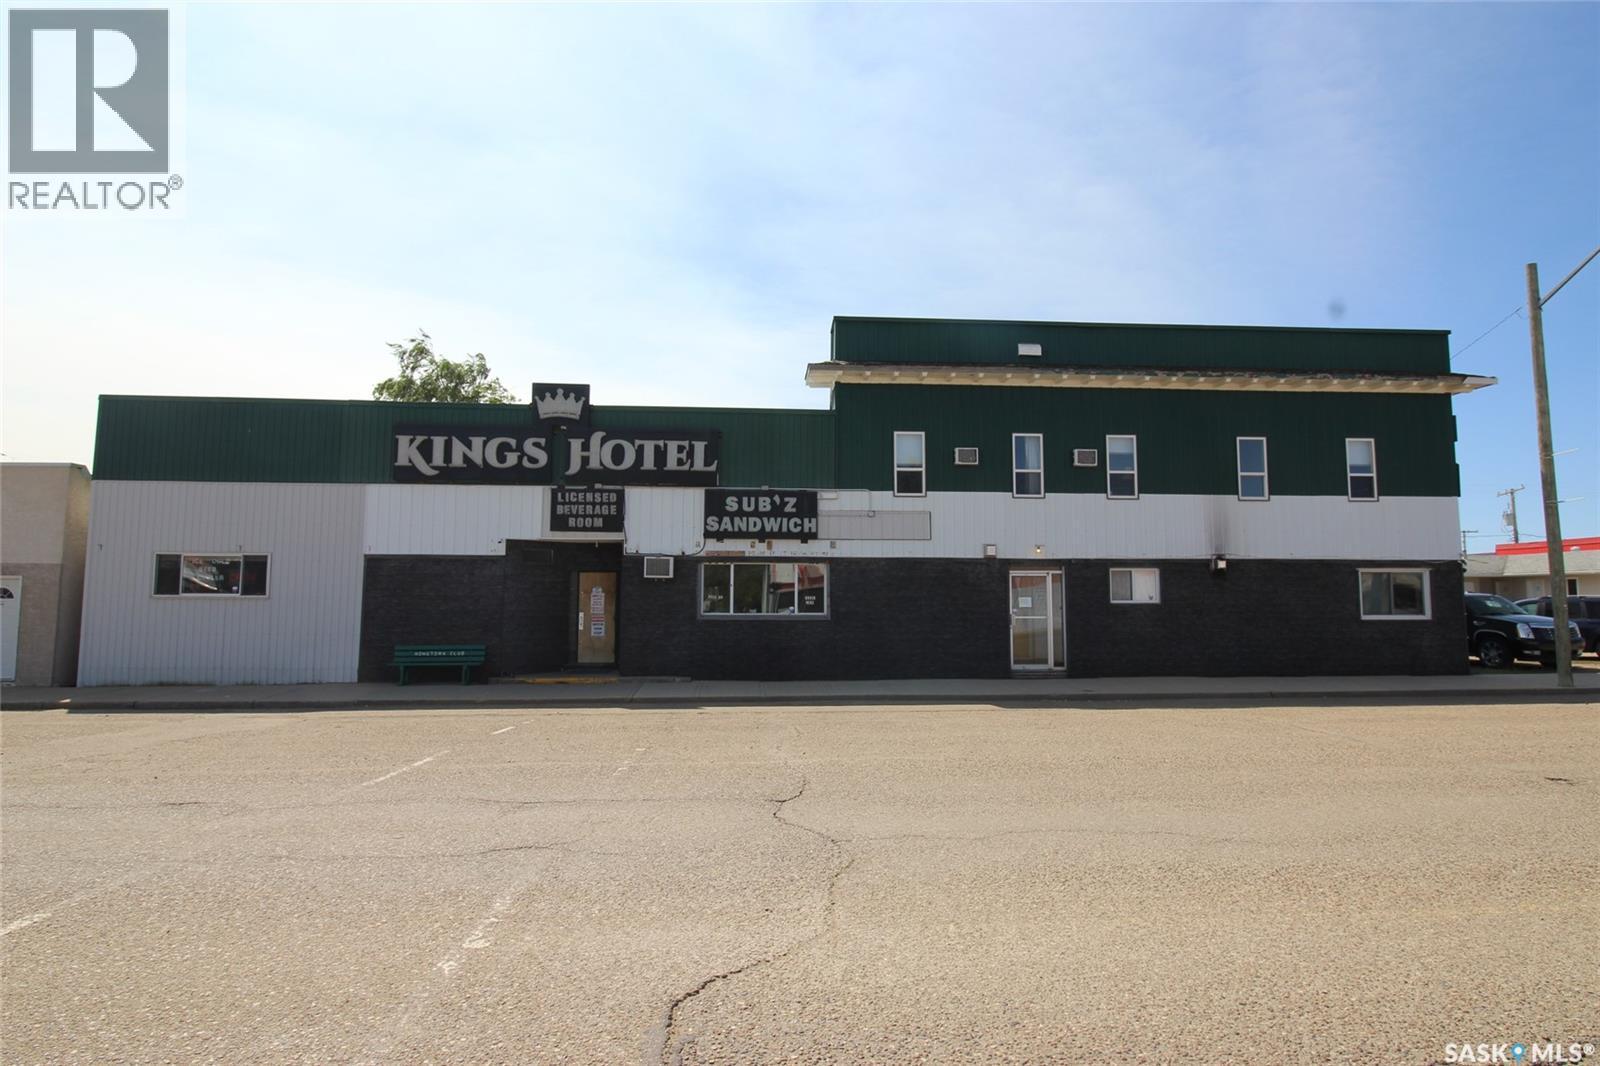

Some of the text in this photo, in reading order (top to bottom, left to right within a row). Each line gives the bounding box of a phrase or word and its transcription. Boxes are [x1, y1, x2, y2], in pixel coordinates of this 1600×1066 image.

[393, 430, 718, 477] KINGS HOTEL
[557, 491, 617, 503] LICENSED
[556, 504, 617, 515] BEVERAGE
[568, 517, 603, 528] ROOM
[705, 516, 817, 533] SANDWICH
